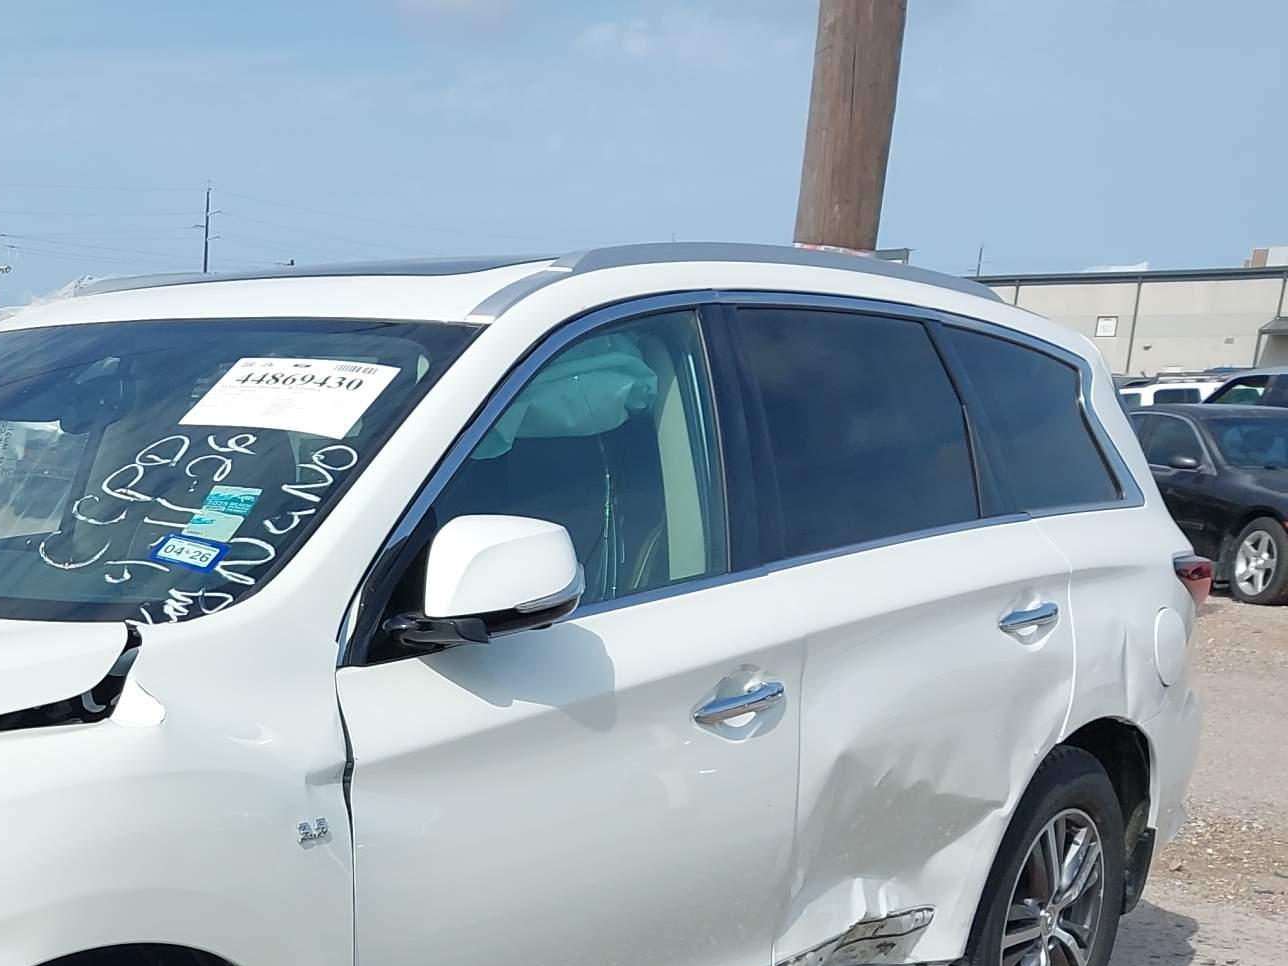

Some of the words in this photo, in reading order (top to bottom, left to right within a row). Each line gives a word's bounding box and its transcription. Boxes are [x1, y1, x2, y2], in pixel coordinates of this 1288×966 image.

[235, 371, 364, 391] 44869430
[164, 543, 185, 556] 04
[189, 550, 212, 563] 26
